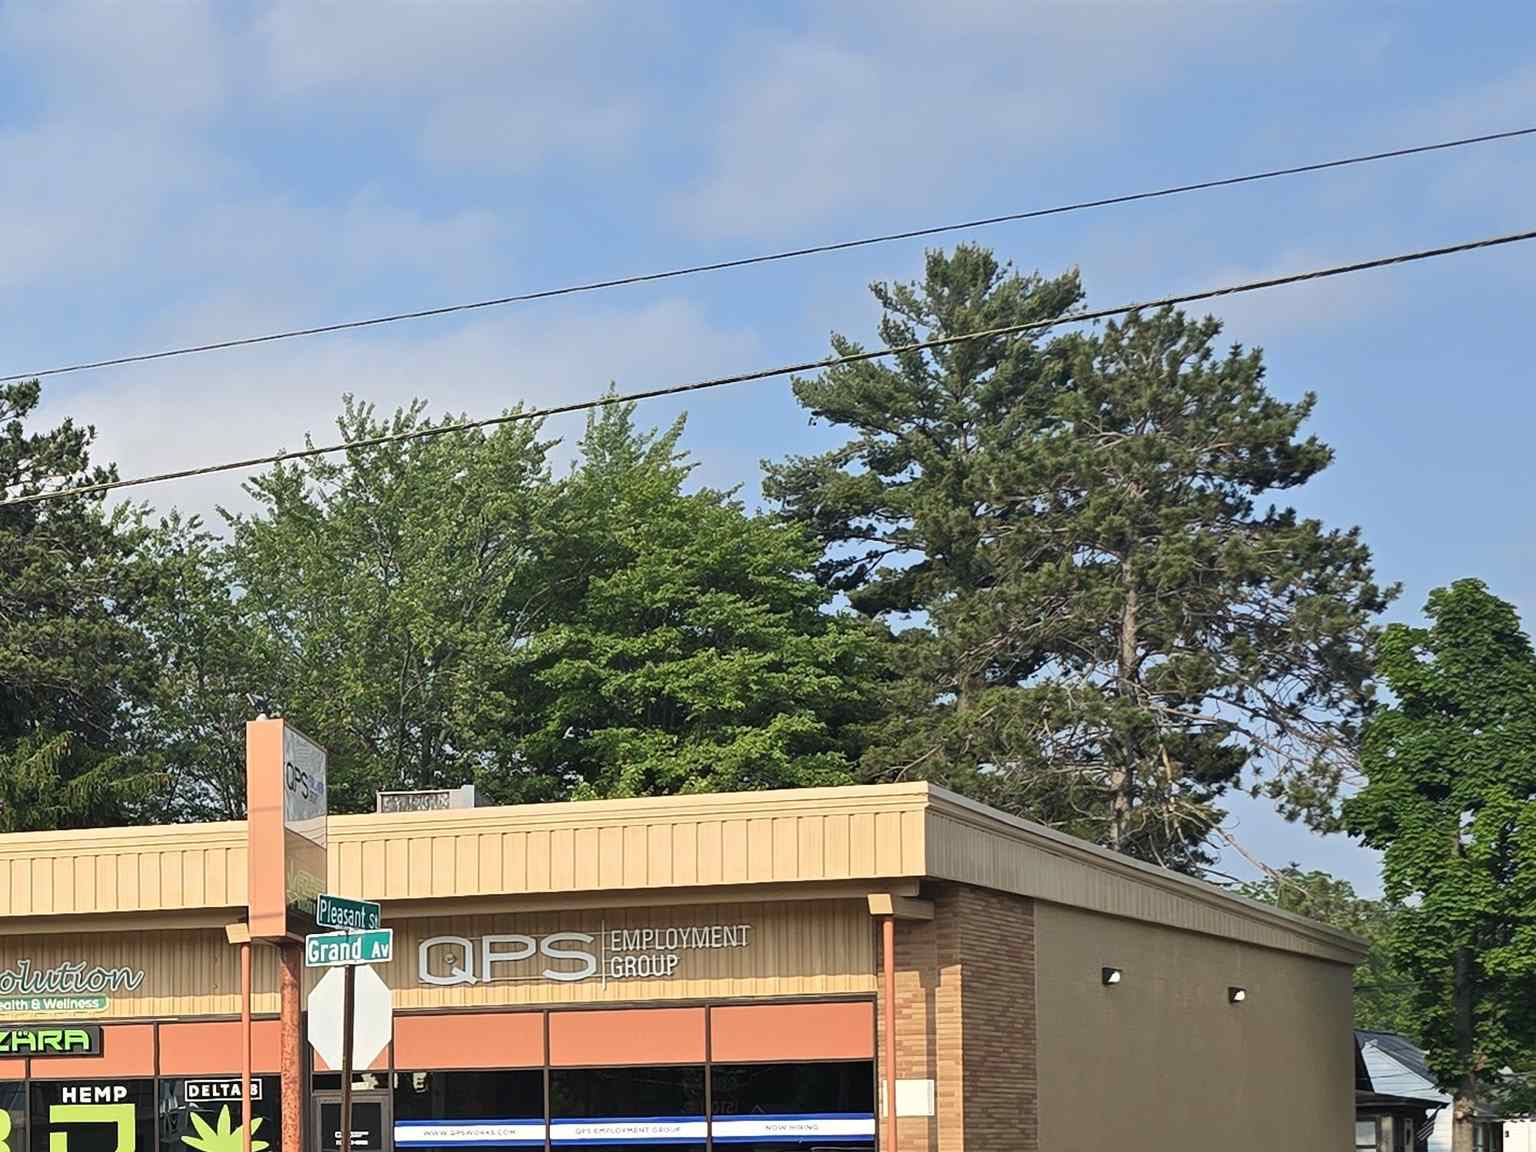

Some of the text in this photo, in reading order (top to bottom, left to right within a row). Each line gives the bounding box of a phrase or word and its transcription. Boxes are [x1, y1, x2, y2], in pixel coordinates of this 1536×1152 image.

[286, 762, 309, 799] QPS
[320, 899, 365, 928] Pleasant
[308, 938, 389, 962] Grand Av
[610, 925, 752, 951] EMPLOYMENT
[418, 932, 598, 985] QPS
[610, 954, 680, 979] GROUP
[31, 999, 40, 1011] &
[45, 997, 99, 1010] Wellness
[62, 1086, 128, 1103] HEMP
[188, 1083, 258, 1098] DELTA 8
[593, 1125, 649, 1135] EMPLOYMENT
